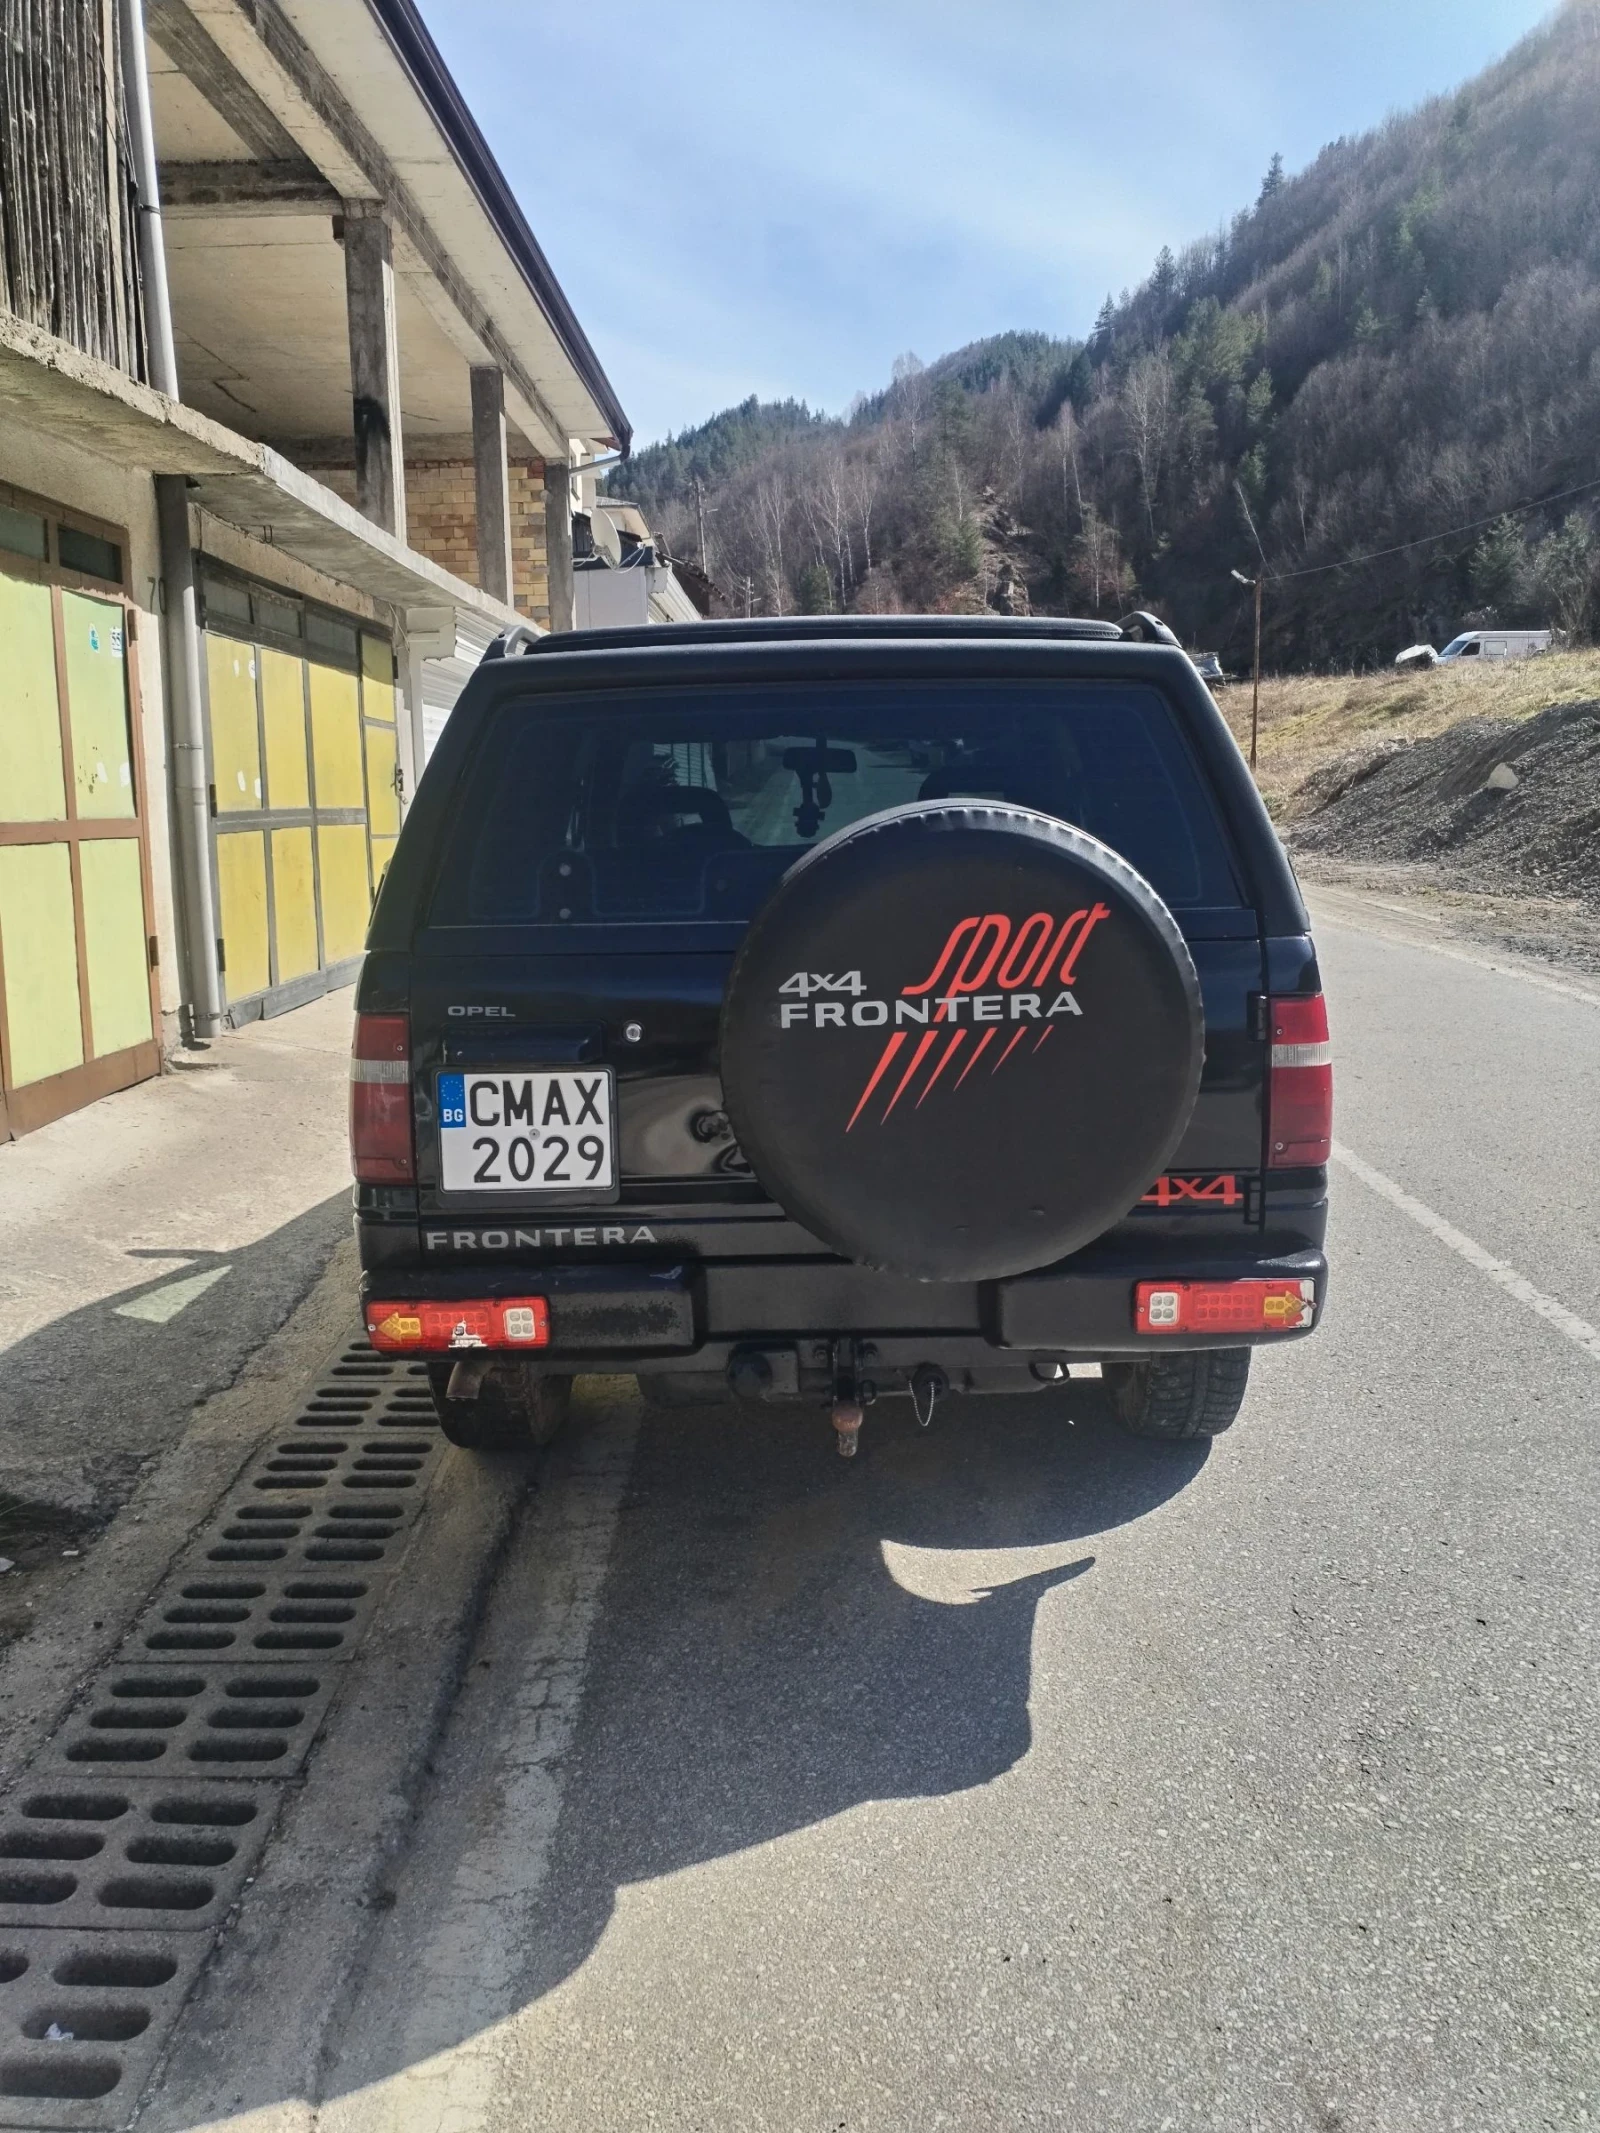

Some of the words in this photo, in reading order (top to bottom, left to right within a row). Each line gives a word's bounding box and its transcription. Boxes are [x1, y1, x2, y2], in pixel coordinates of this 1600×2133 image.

[447, 1006, 516, 1017] OPEL
[781, 991, 1083, 1028] FRONTERA
[443, 1108, 464, 1123] BG
[472, 1135, 605, 1184] 2029
[426, 1226, 657, 1250] FRONTERA
